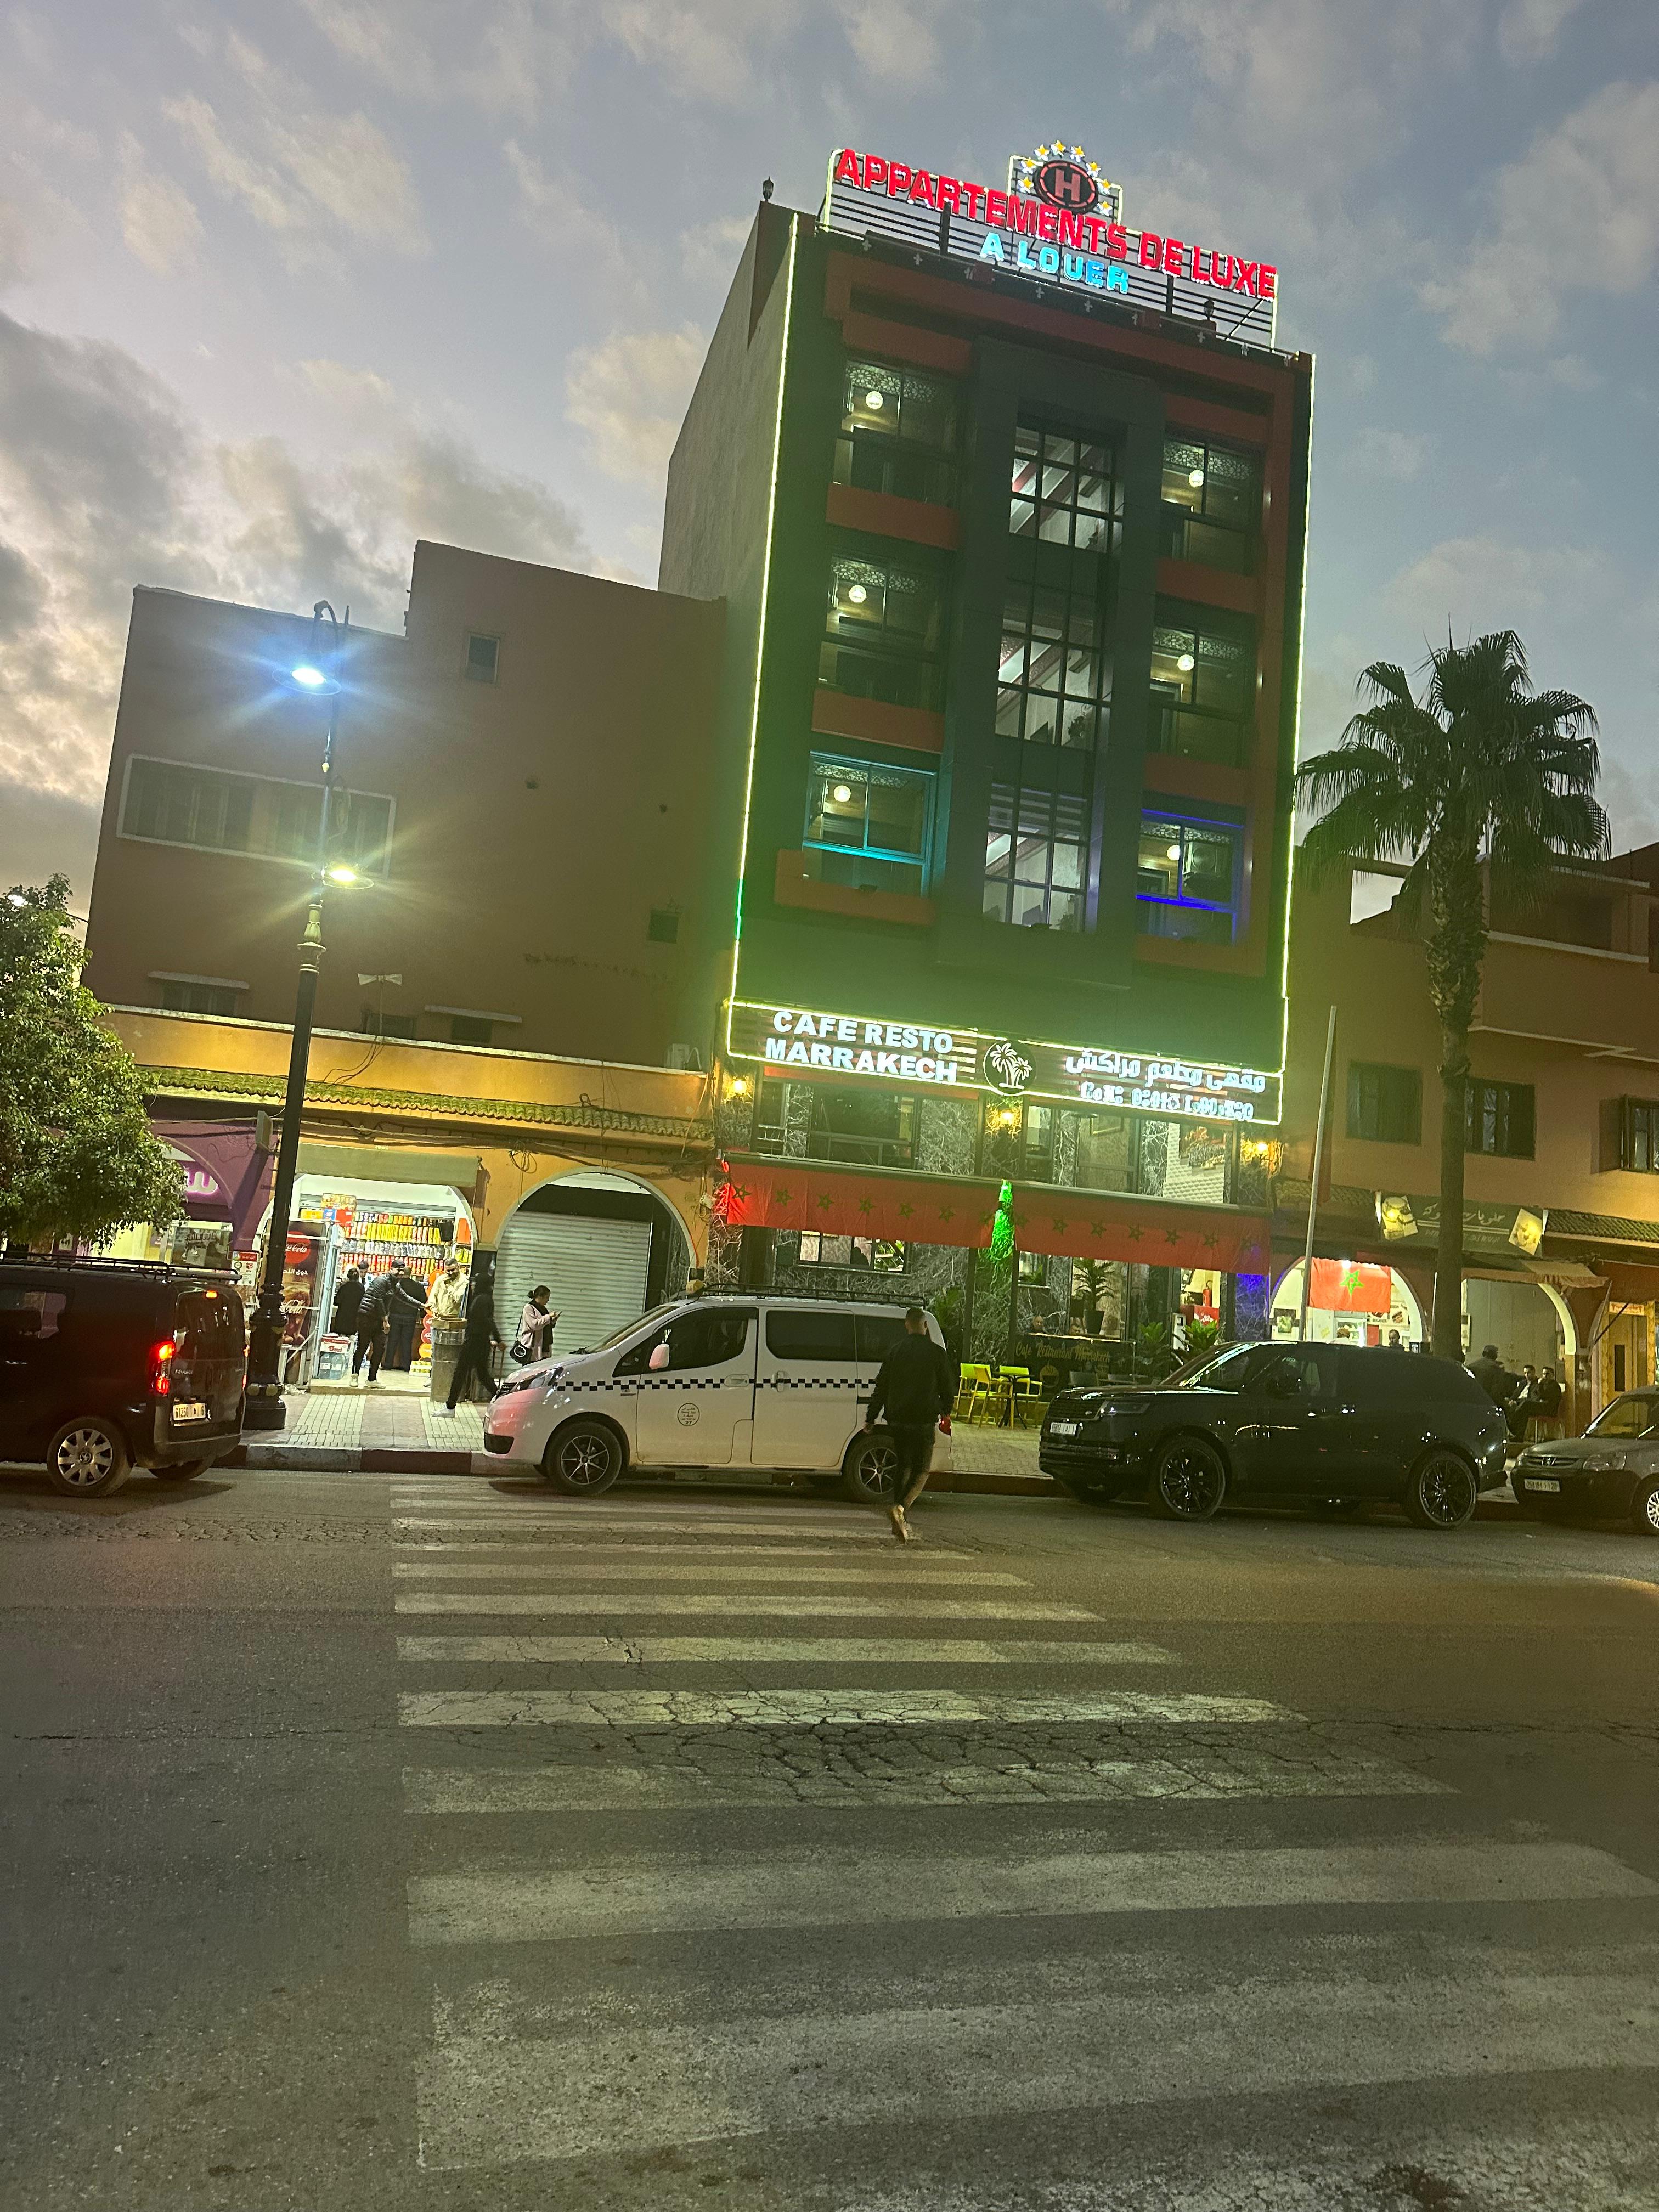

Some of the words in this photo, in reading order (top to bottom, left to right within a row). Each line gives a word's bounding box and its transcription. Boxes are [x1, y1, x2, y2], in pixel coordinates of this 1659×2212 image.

[1055, 168, 1080, 202] H
[834, 149, 1127, 260] APPARTEMENTS
[1139, 231, 1185, 276] DE
[1192, 245, 1277, 302] LUXE
[980, 232, 1004, 262] A
[1018, 240, 1128, 295] LOUER
[774, 1011, 859, 1042] CAFE
[864, 1023, 953, 1054] RESTO
[765, 1037, 957, 1083] MARRAKECH
[1065, 1047, 1141, 1079] مراكش
[1144, 1061, 1203, 1087] مطعم
